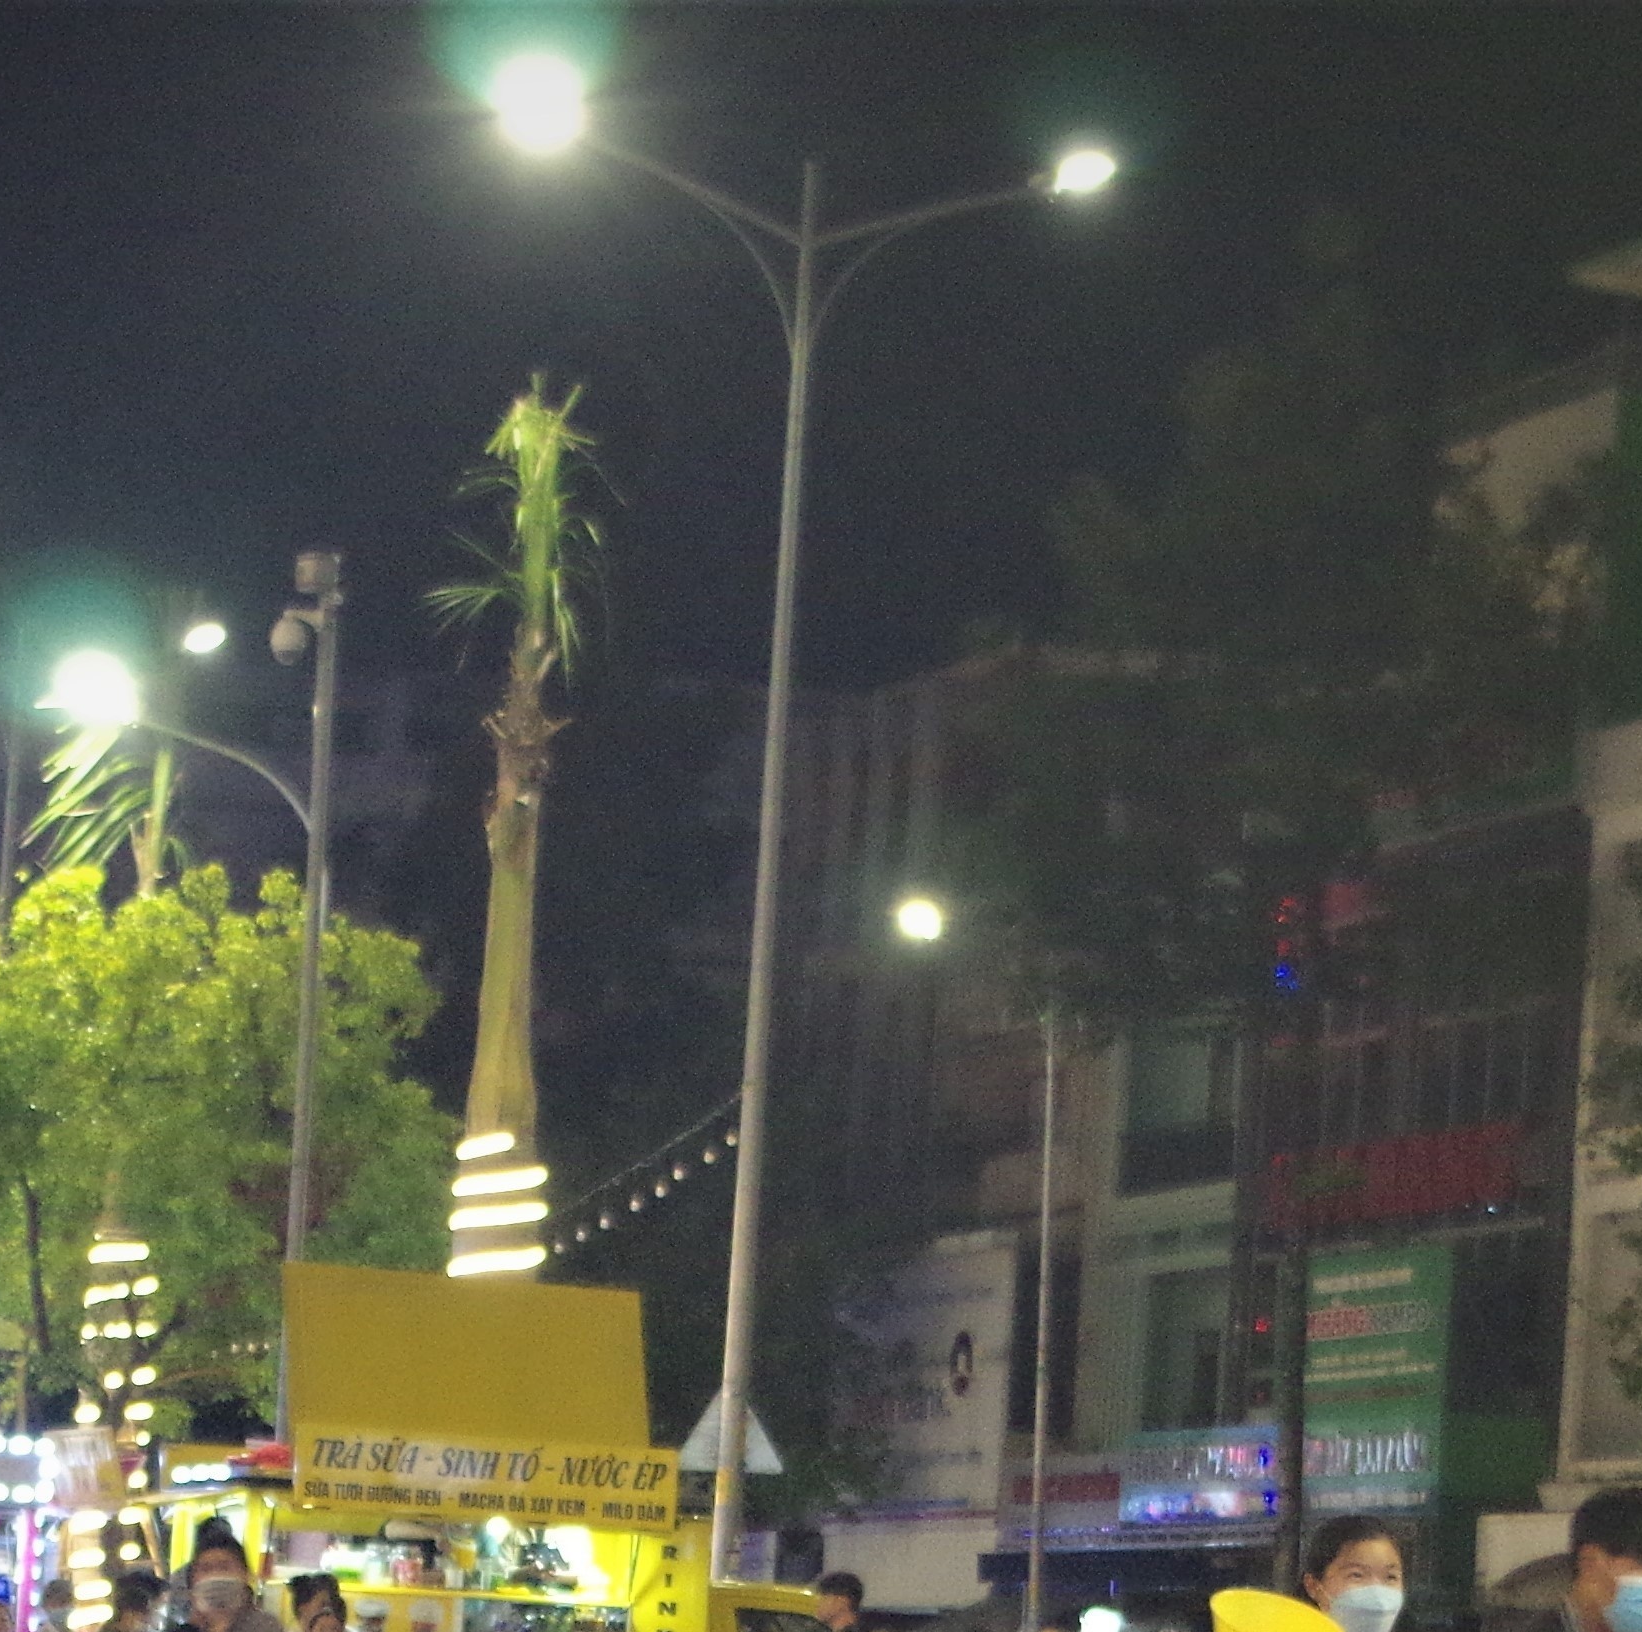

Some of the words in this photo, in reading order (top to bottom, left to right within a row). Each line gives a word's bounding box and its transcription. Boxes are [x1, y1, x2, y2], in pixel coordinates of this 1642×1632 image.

[312, 1435, 364, 1469] TRÀ
[366, 1435, 421, 1474] SỮA
[438, 1446, 500, 1480] SINH
[507, 1446, 544, 1482] TỐ
[559, 1454, 629, 1489] NƯỚC
